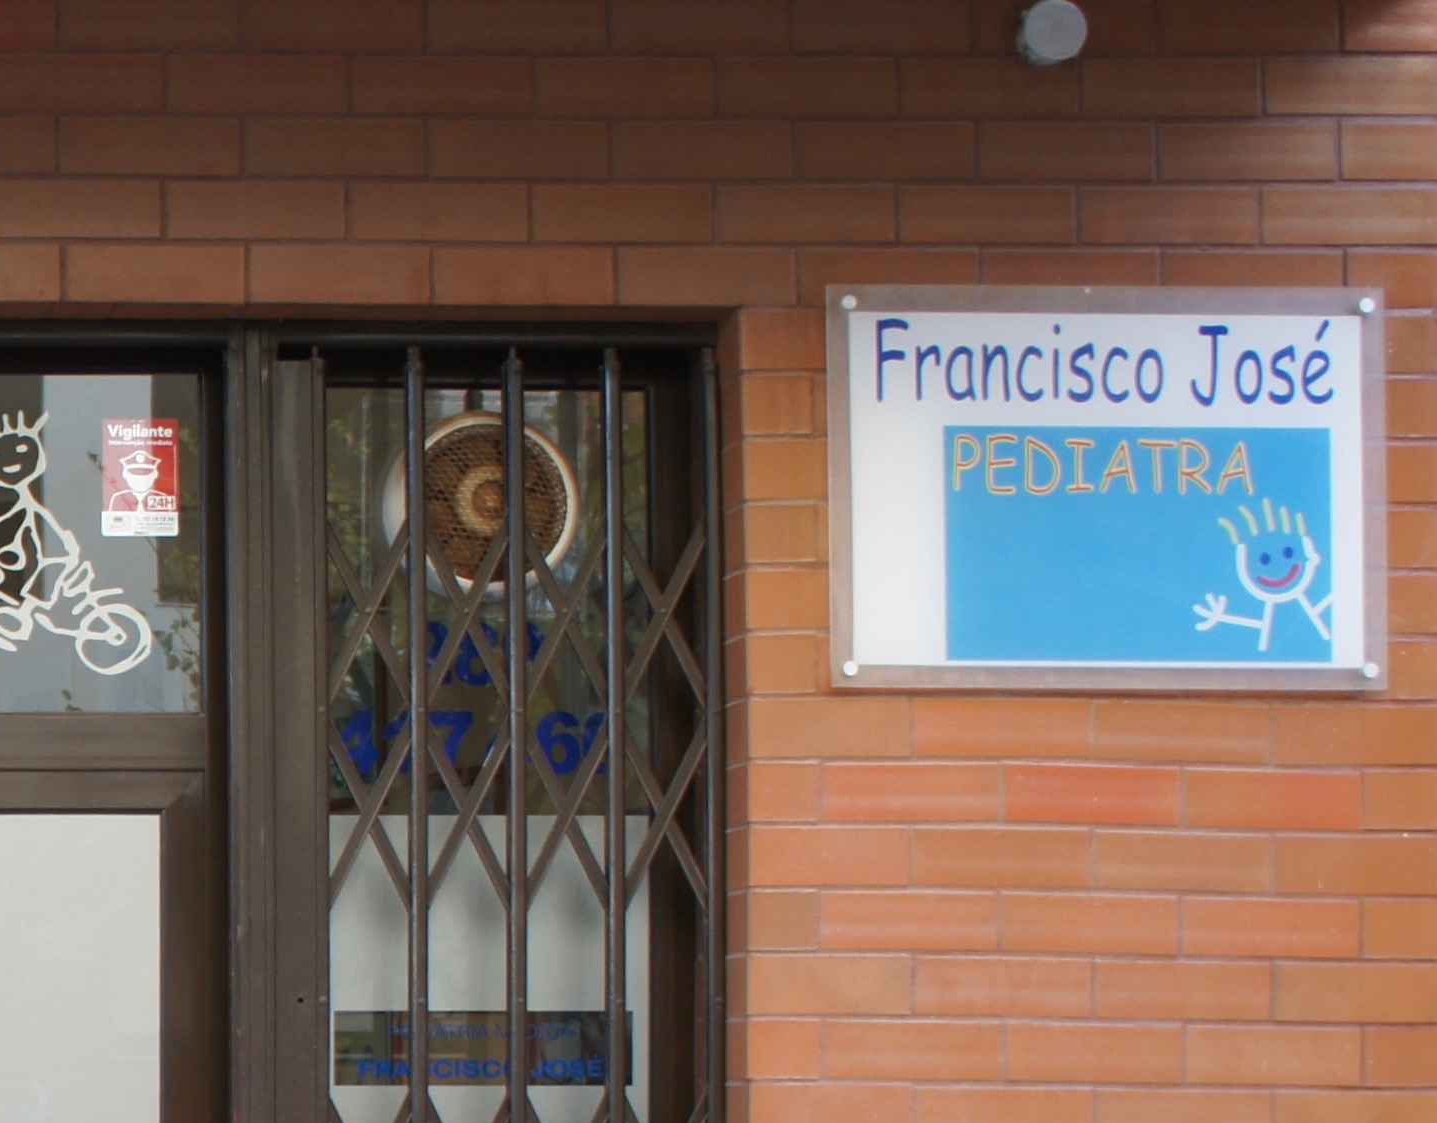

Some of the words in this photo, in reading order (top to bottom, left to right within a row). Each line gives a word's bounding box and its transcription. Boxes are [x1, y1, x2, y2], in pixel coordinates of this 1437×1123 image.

[874, 318, 1165, 403] Francisco
[1190, 319, 1335, 406] José
[107, 424, 173, 440] Vigilante
[952, 434, 1254, 495] PEDIATRA
[149, 498, 174, 509] 24H
[357, 1058, 515, 1079] FRACISC
[531, 1054, 604, 1079] JOSÉ
